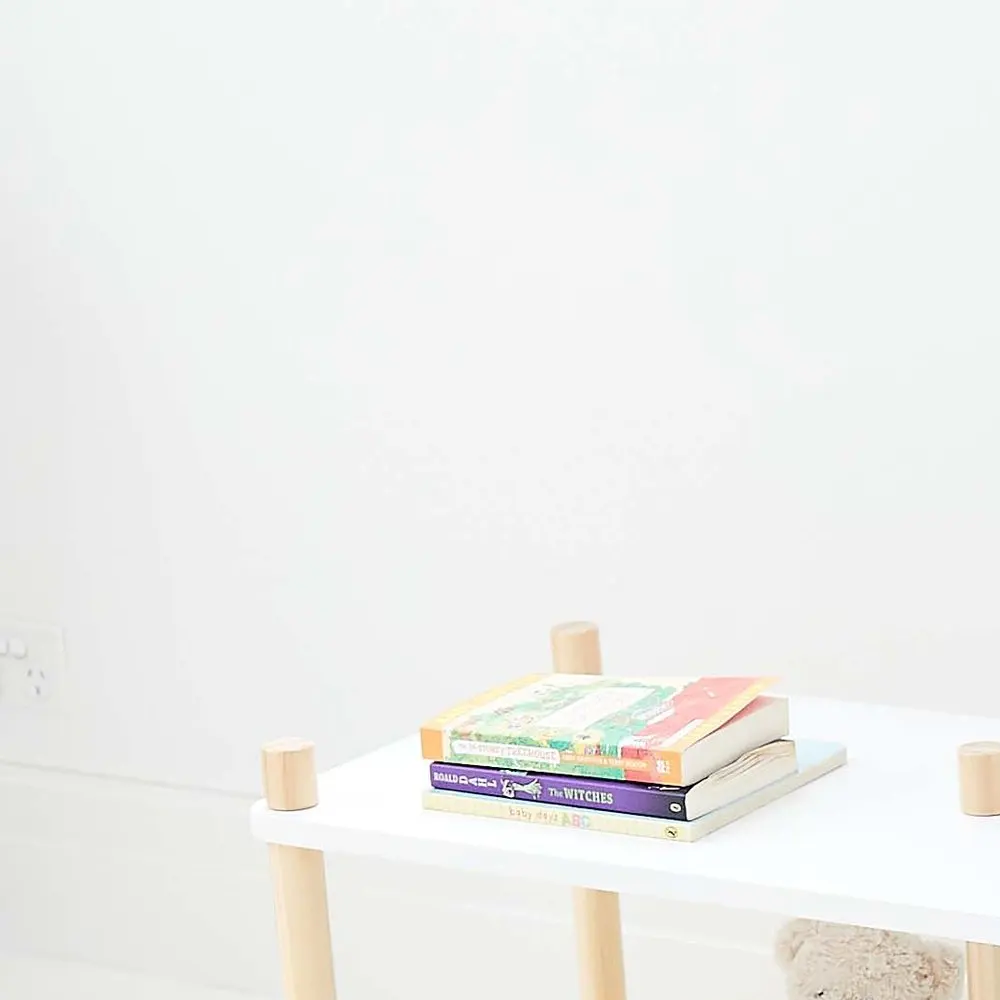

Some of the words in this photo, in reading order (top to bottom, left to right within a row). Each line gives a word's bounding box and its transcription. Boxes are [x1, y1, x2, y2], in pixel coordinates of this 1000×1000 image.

[433, 772, 459, 784] ROALD
[460, 776, 498, 787] DAHL
[548, 787, 564, 798] The
[563, 787, 614, 804] WITCHES
[509, 806, 532, 821] baby
[562, 813, 591, 829] ABC
